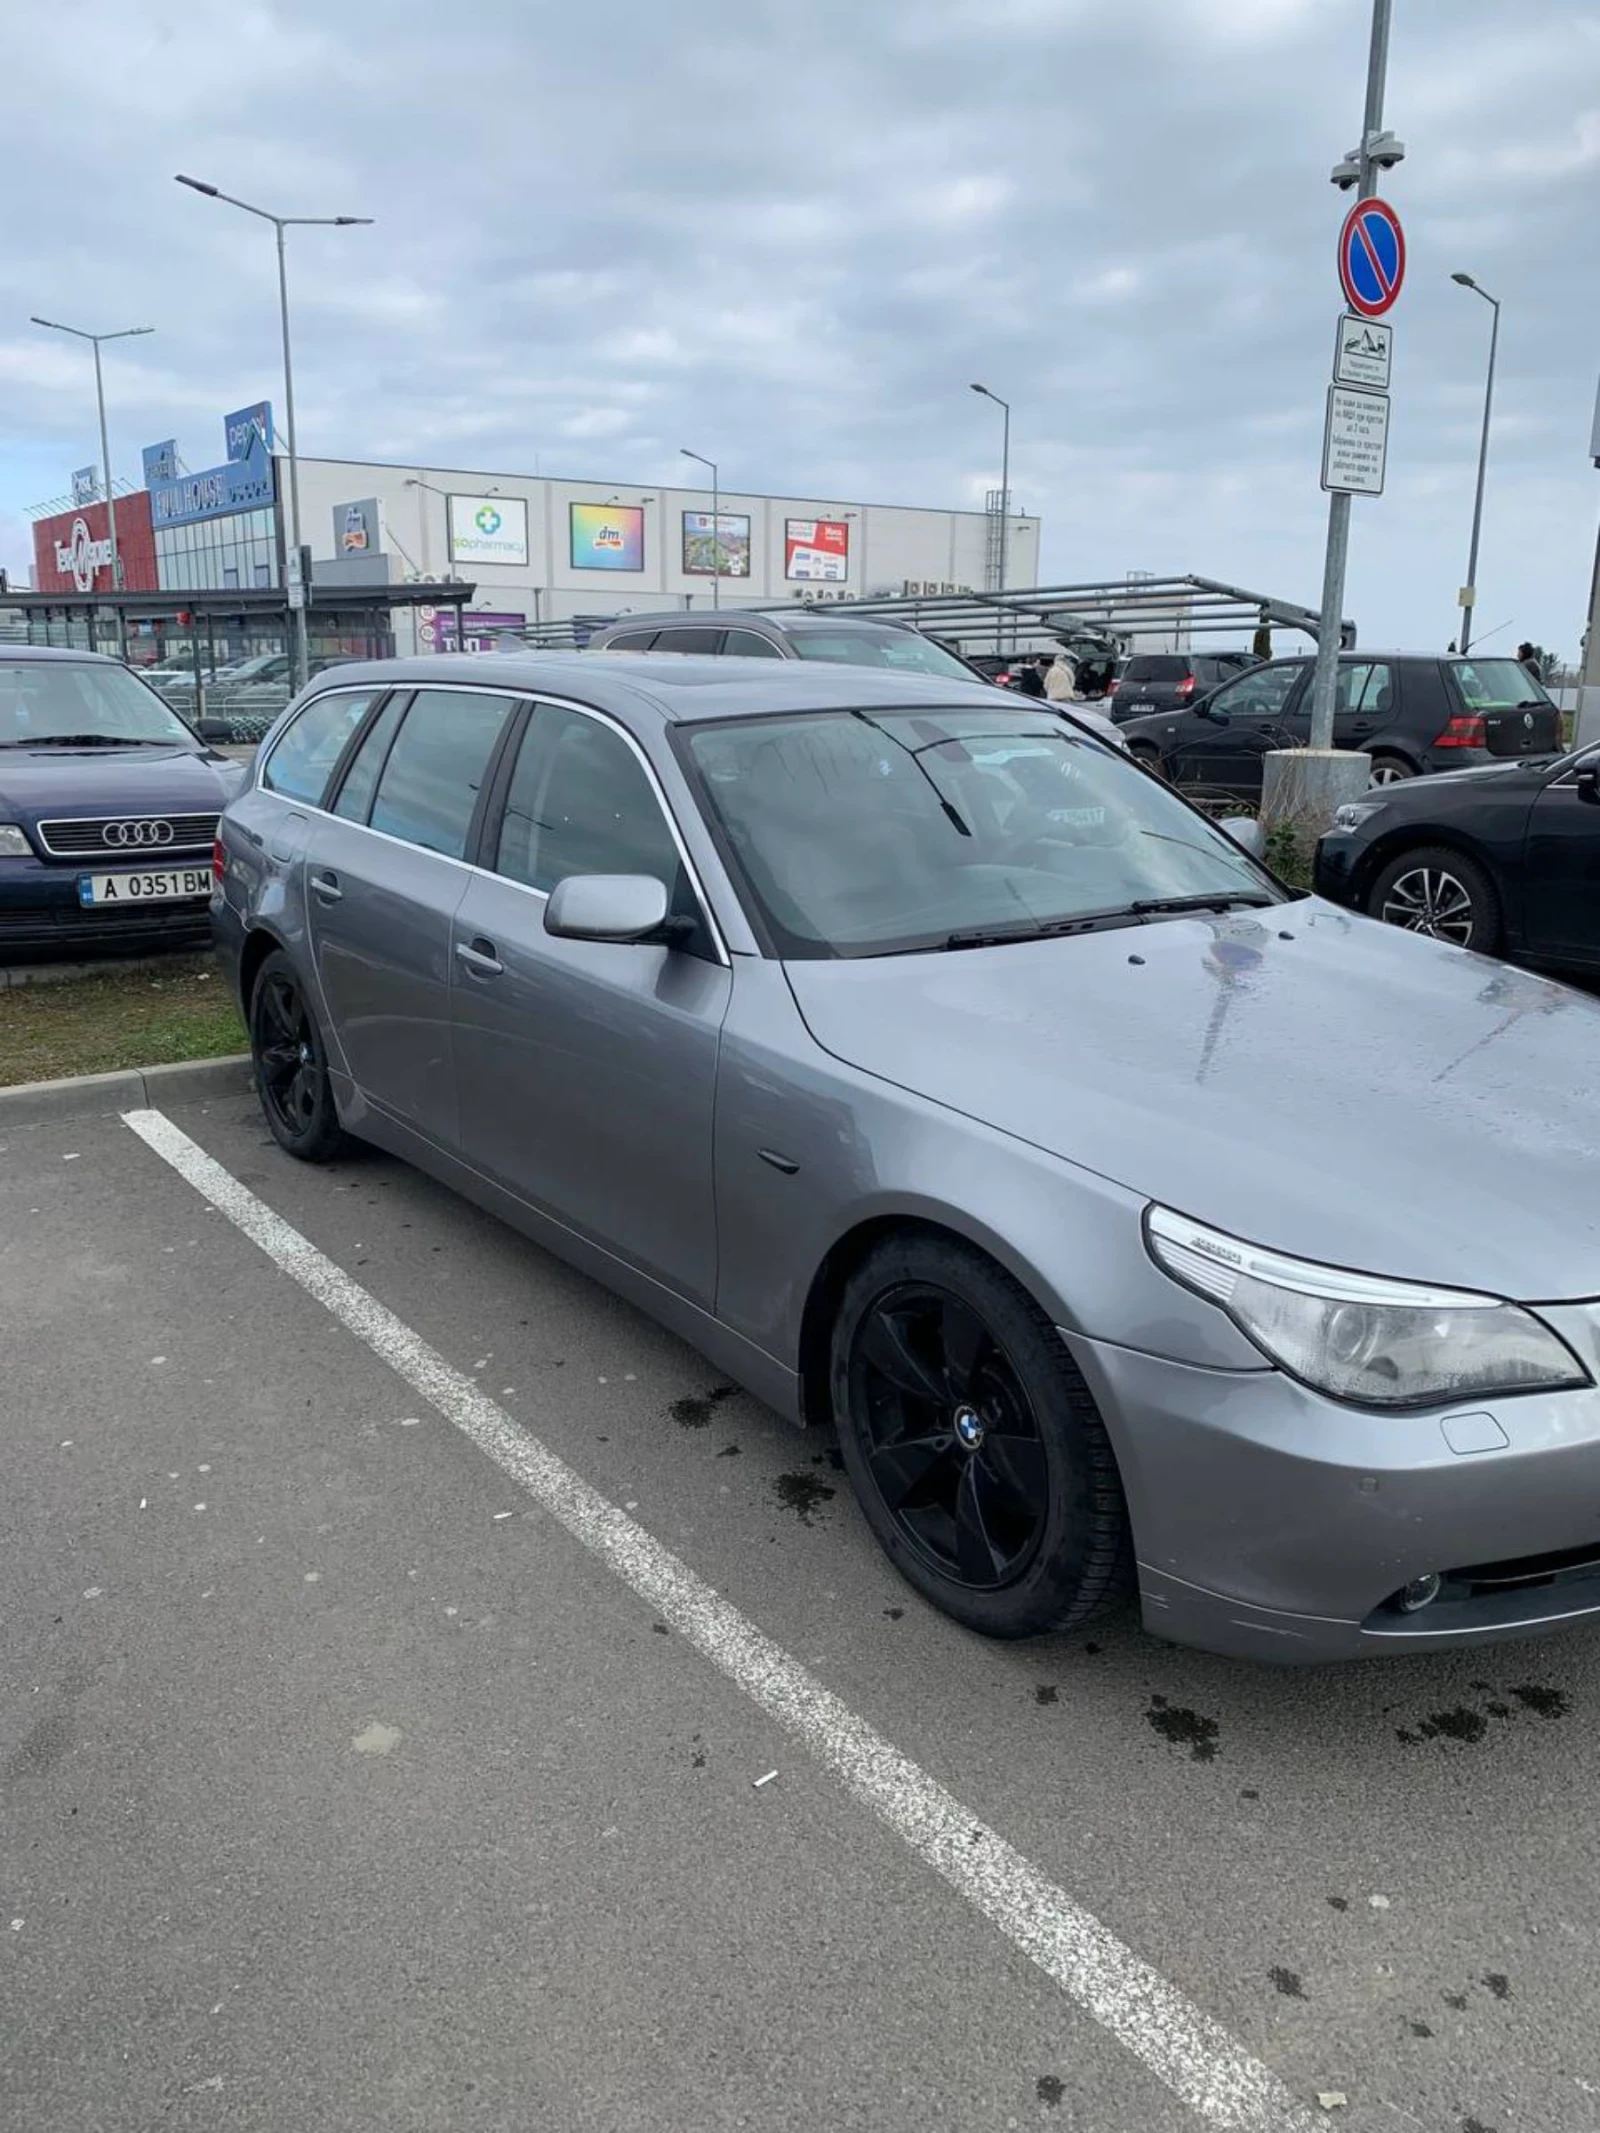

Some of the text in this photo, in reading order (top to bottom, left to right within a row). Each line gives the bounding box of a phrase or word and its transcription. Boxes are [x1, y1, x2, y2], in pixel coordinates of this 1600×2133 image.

[184, 474, 224, 513] HOUSE
[599, 526, 619, 539] dm
[104, 878, 118, 898] A
